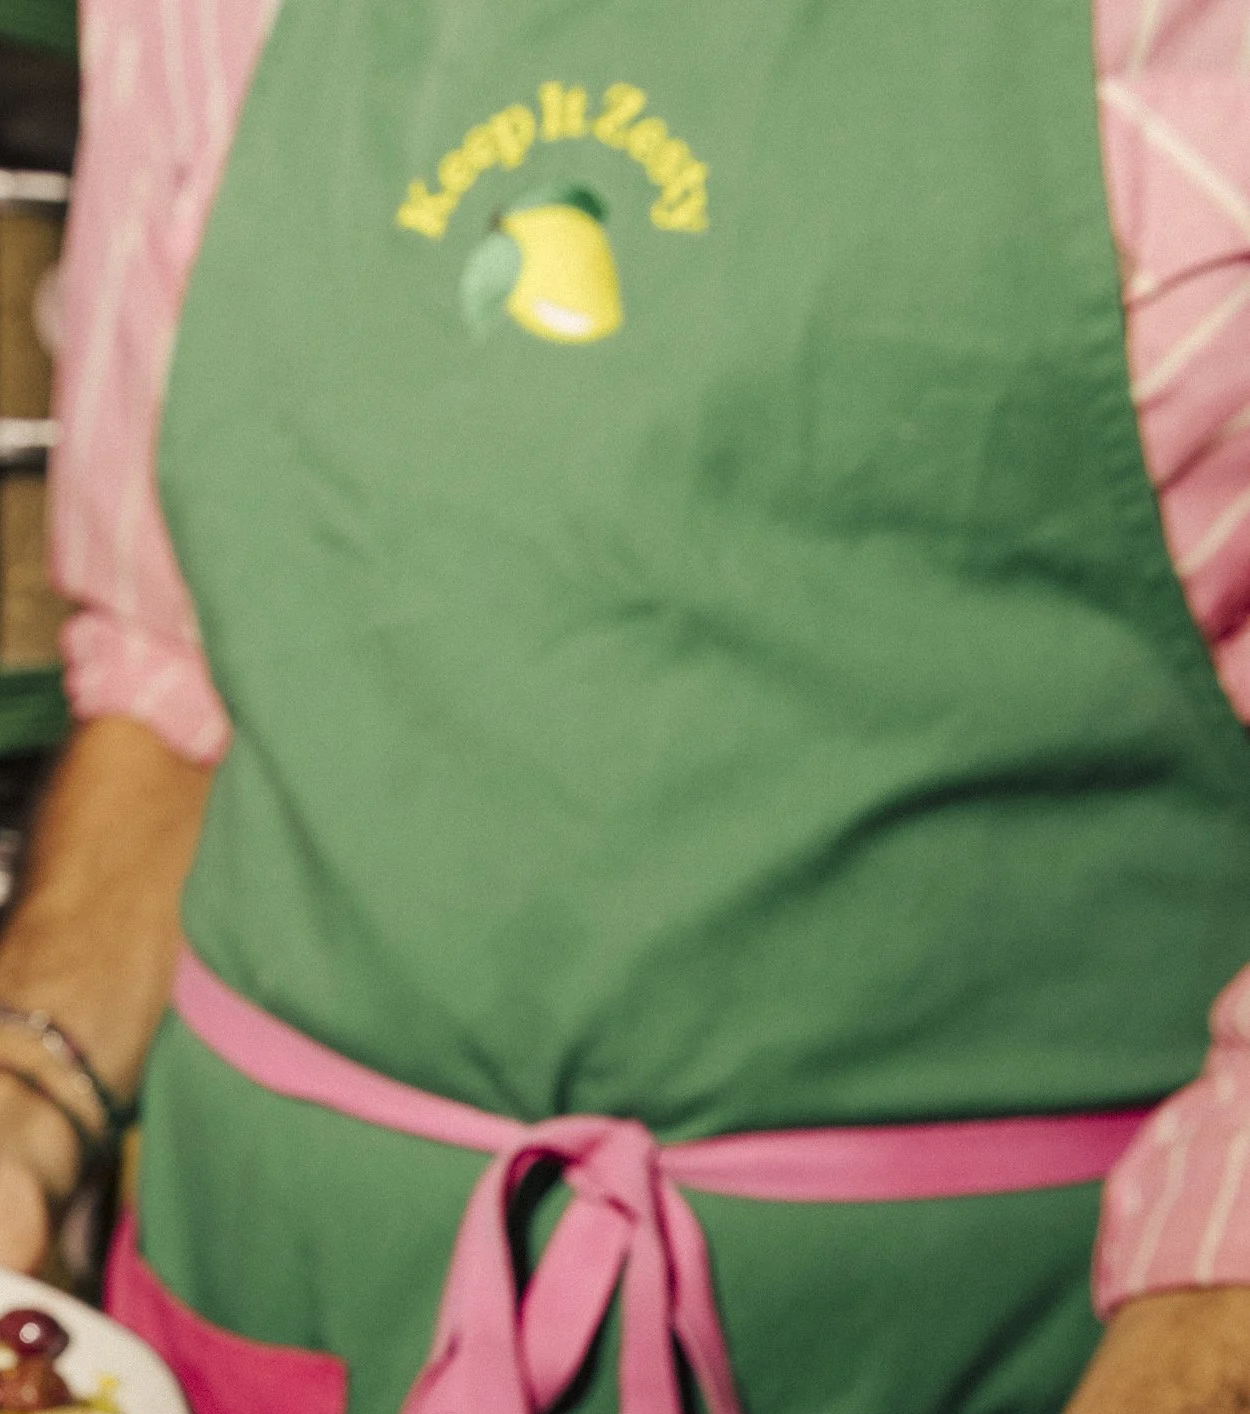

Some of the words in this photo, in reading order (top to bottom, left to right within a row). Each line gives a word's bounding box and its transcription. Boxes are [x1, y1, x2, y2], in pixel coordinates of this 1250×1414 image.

[396, 104, 535, 239] Keep
[539, 82, 587, 141] It
[593, 83, 708, 231] Zesty
